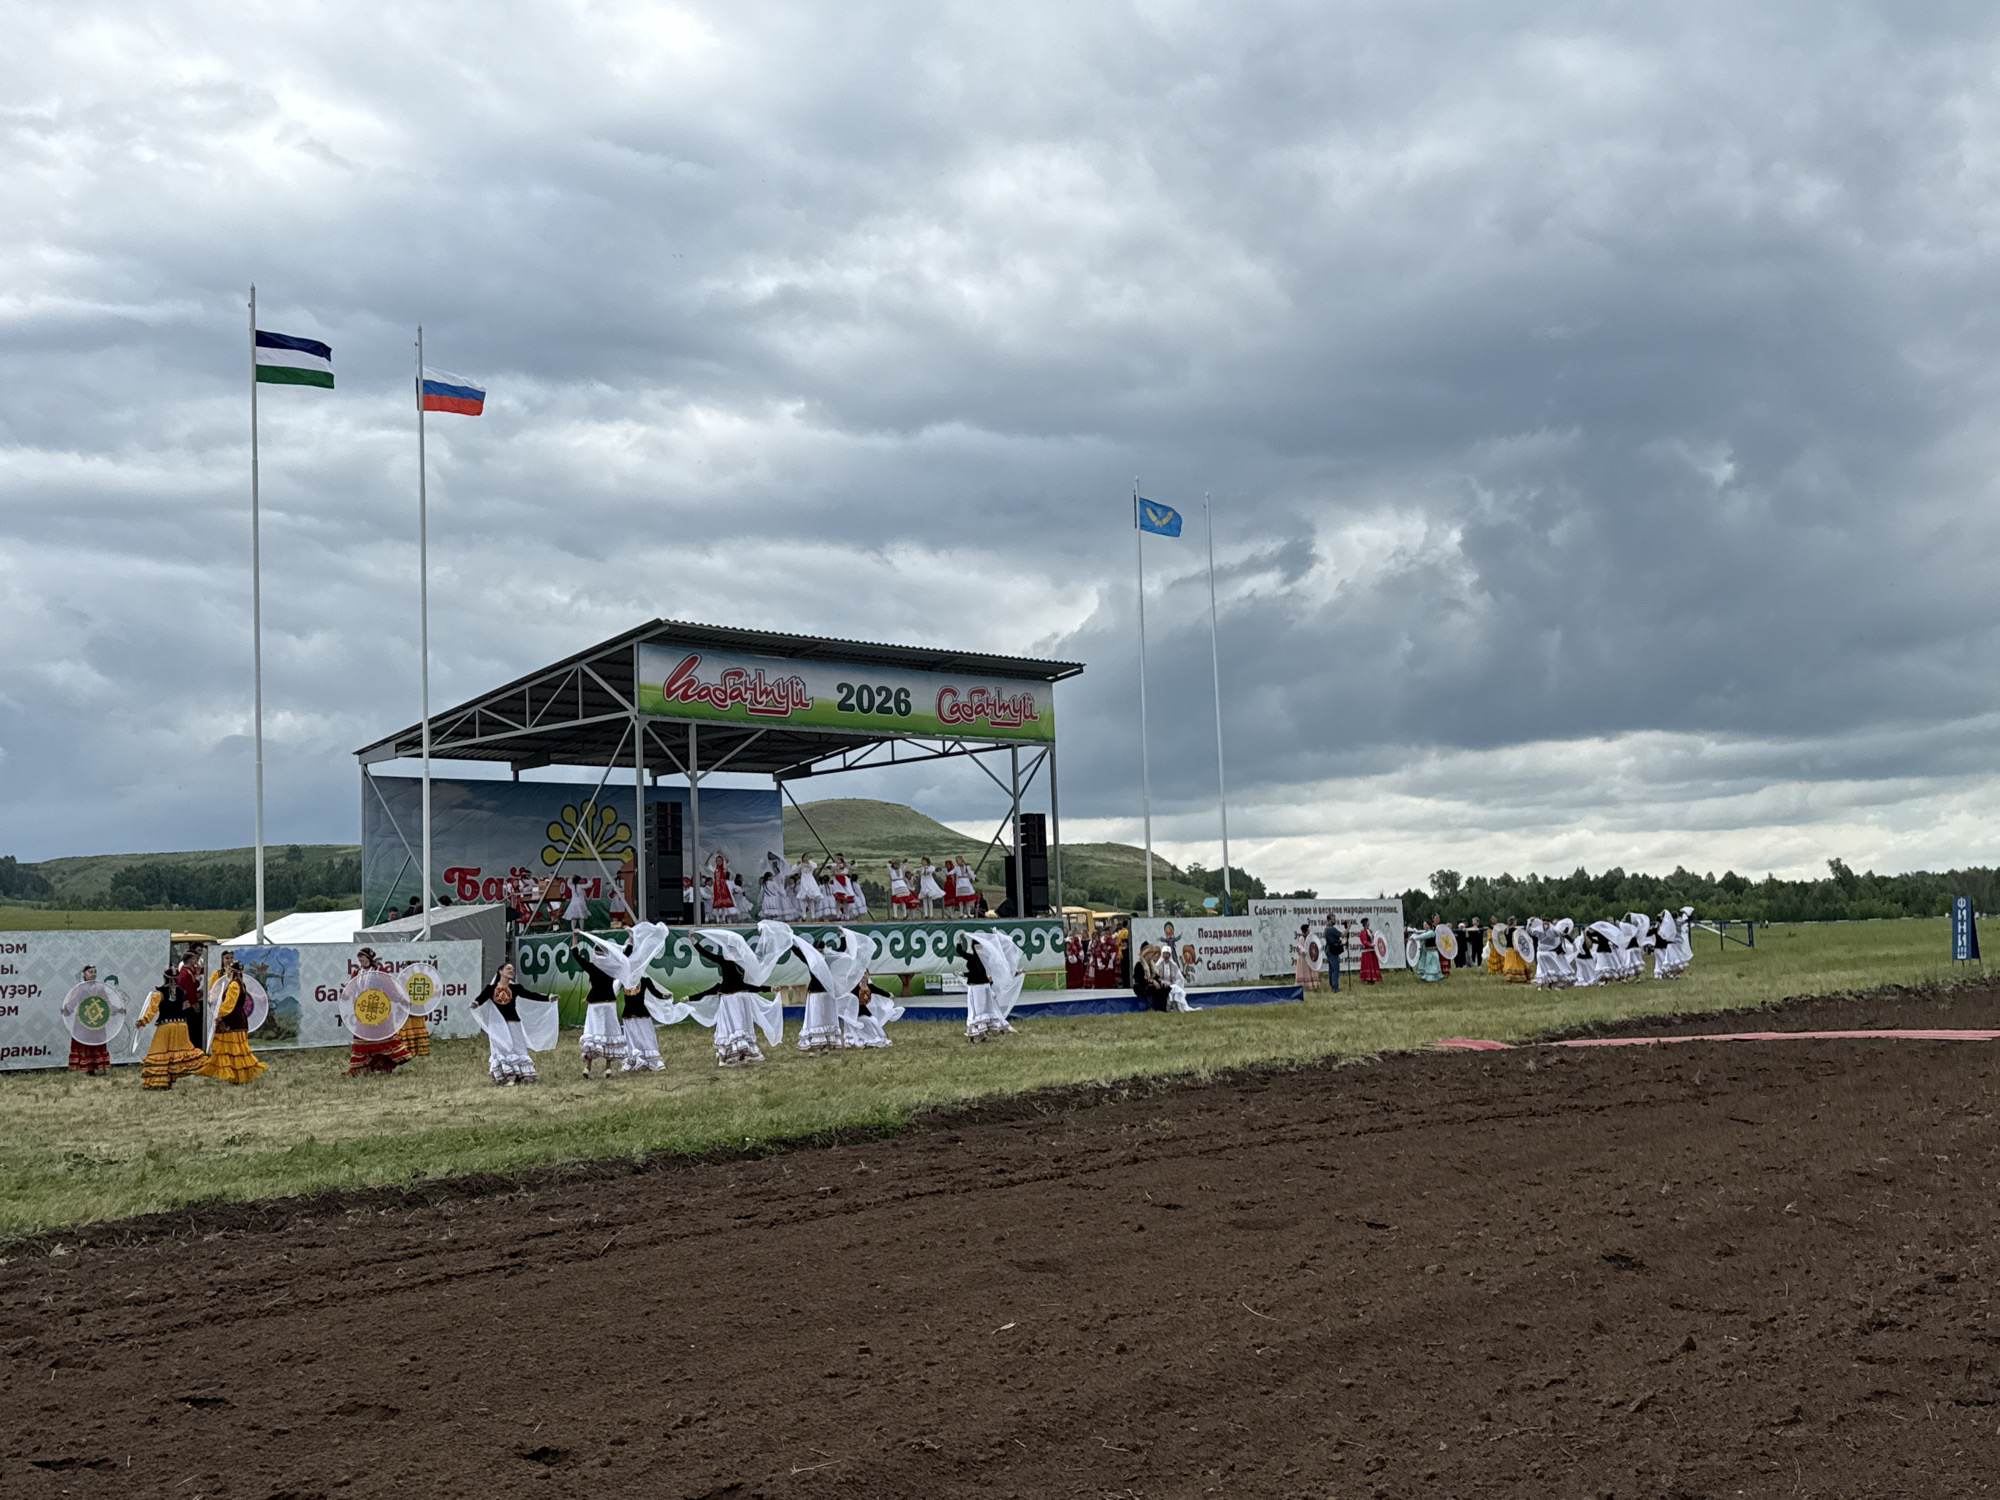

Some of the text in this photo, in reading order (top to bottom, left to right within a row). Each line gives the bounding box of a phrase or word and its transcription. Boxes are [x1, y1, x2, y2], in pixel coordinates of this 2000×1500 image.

[836, 682, 911, 717] 2026
[1254, 905, 1287, 917] Сабантуй
[1197, 928, 1252, 940] Поздравляем
[1957, 896, 1967, 959] ФИНИШ
[1198, 945, 1253, 957] с праздником
[1206, 958, 1248, 972] Сабантуй!
